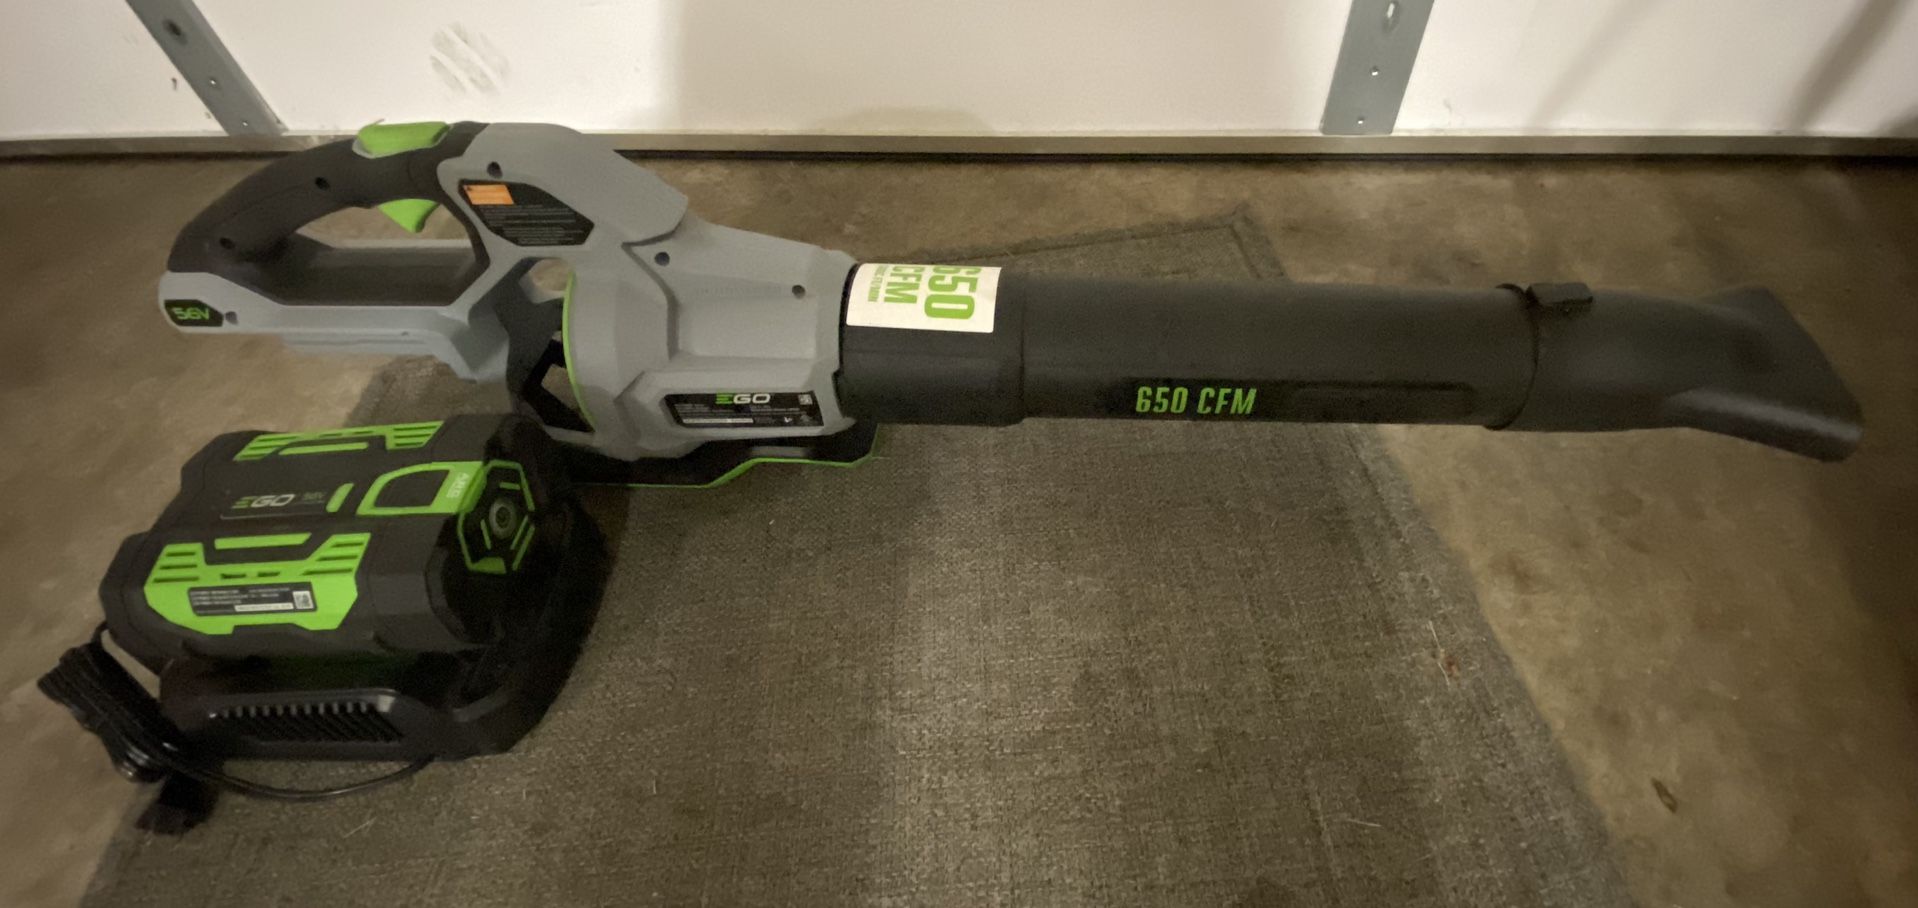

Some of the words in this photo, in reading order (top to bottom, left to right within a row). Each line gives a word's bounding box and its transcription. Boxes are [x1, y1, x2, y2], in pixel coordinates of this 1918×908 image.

[884, 266, 925, 304] CFM
[924, 266, 981, 319] 650
[171, 307, 209, 319] 56V
[715, 393, 771, 404] EGO
[1135, 386, 1189, 413] 650
[1196, 387, 1257, 414] CFM
[232, 494, 295, 508] EGO
